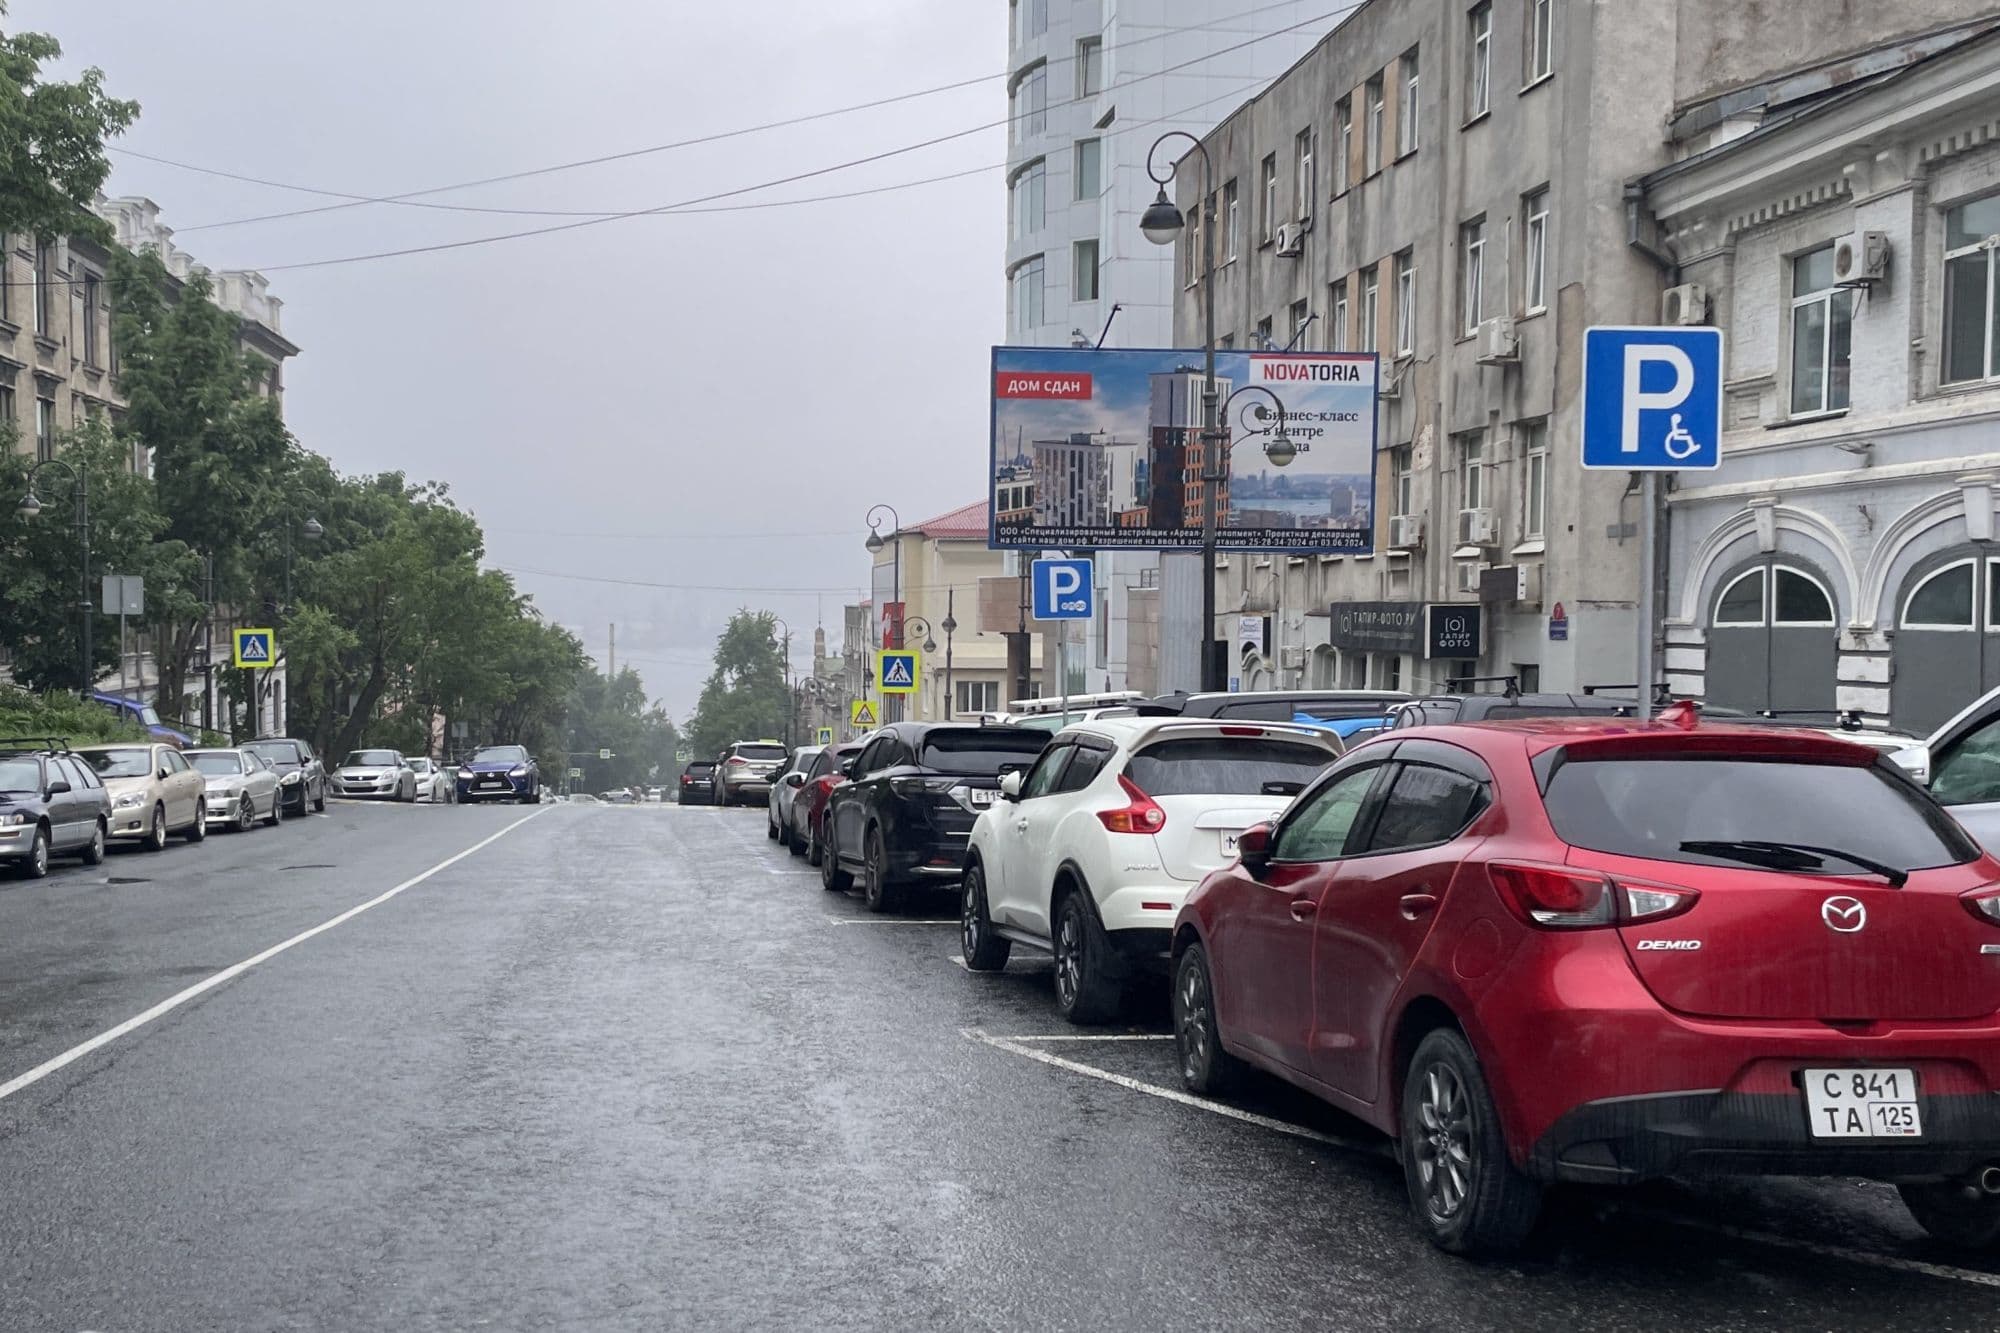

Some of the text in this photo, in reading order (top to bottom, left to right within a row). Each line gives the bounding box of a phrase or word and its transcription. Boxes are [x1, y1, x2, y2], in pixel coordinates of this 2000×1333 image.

[1264, 364, 1360, 381] NOVATORIA
[1007, 379, 1080, 394] ДОМ СДАН
[1621, 344, 1694, 452] P
[1000, 527, 1018, 535] ООО
[1021, 527, 1116, 537] «Специализированный
[1119, 528, 1168, 537] застройщик
[1265, 529, 1310, 539] Проектная
[1312, 530, 1360, 539] декларация
[1013, 535, 1036, 544] сайте
[1093, 536, 1143, 545] Разрешение
[1157, 538, 1179, 546] ввод
[1050, 566, 1080, 613] P
[1440, 632, 1470, 640] ТАПИР
[1439, 640, 1470, 648] ФОТО
[1636, 940, 1702, 950] DEMIO
[1852, 1073, 1899, 1099] 841
[1876, 1106, 1914, 1126] 125
[1885, 1126, 1903, 1134] RUS
